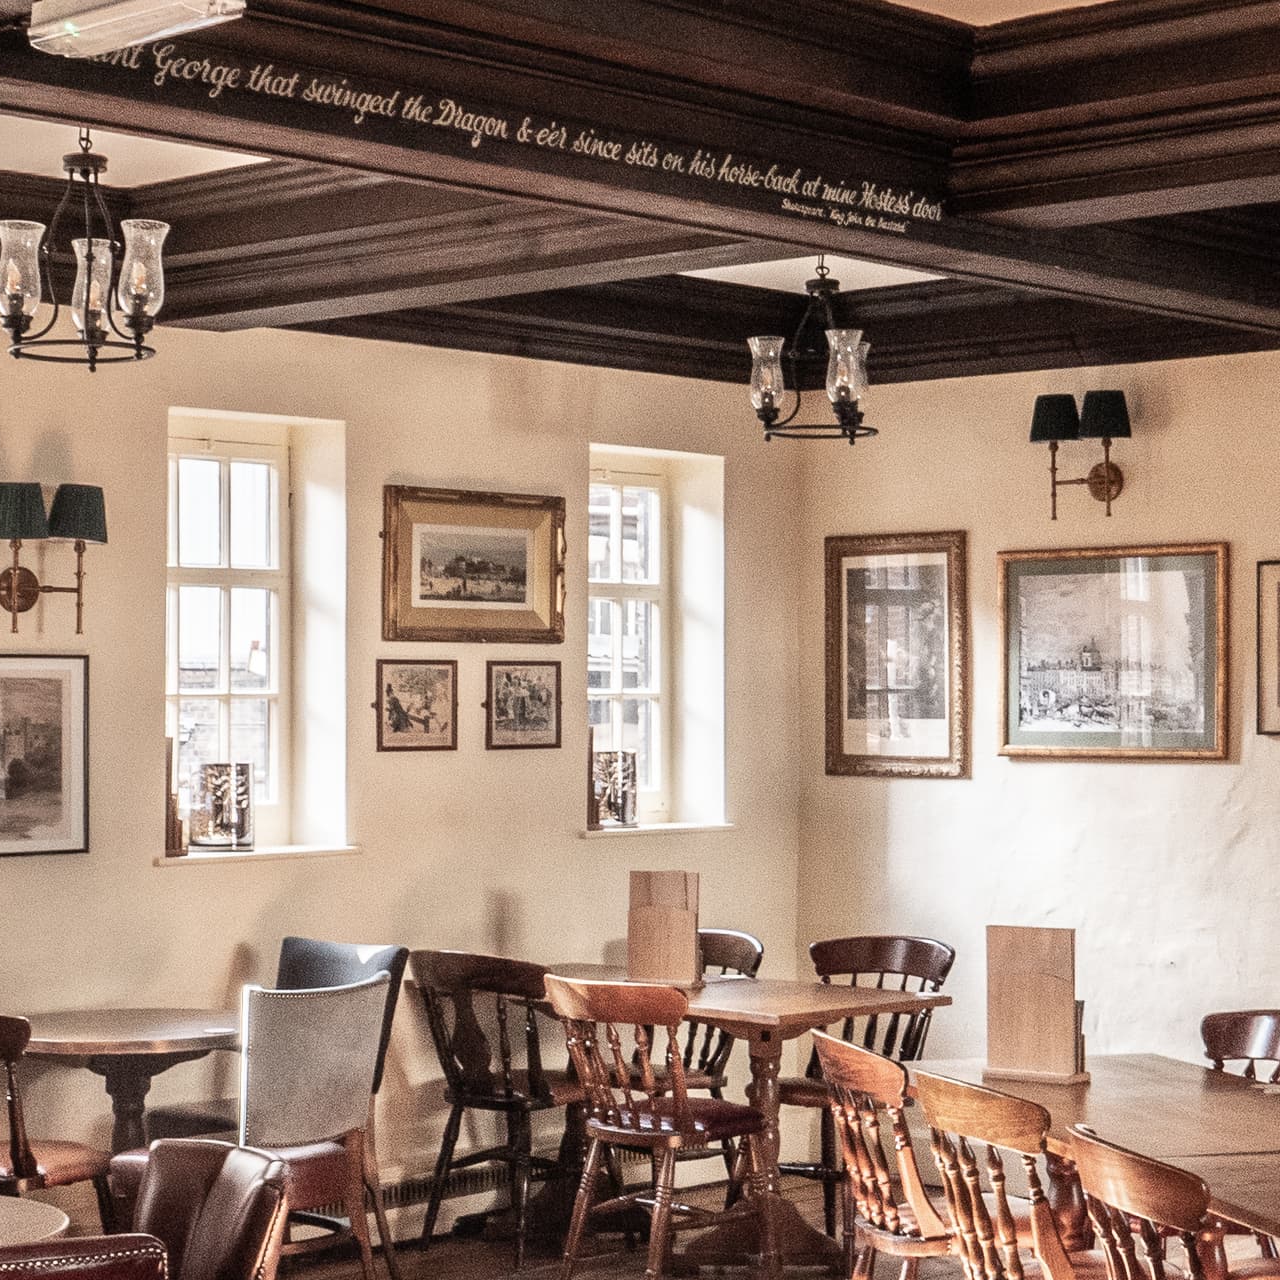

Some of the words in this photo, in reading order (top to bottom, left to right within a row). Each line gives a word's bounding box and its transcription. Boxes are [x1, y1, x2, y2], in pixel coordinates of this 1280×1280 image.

[152, 42, 241, 98] George
[245, 64, 299, 98] that
[303, 79, 401, 124] swinged
[401, 95, 433, 123] the
[432, 98, 509, 148] Dragon
[516, 116, 532, 143] &
[572, 129, 622, 160] since
[625, 141, 658, 167] sits
[662, 152, 685, 173] on
[688, 150, 716, 178] his
[802, 176, 821, 197] at
[821, 180, 857, 205] mine
